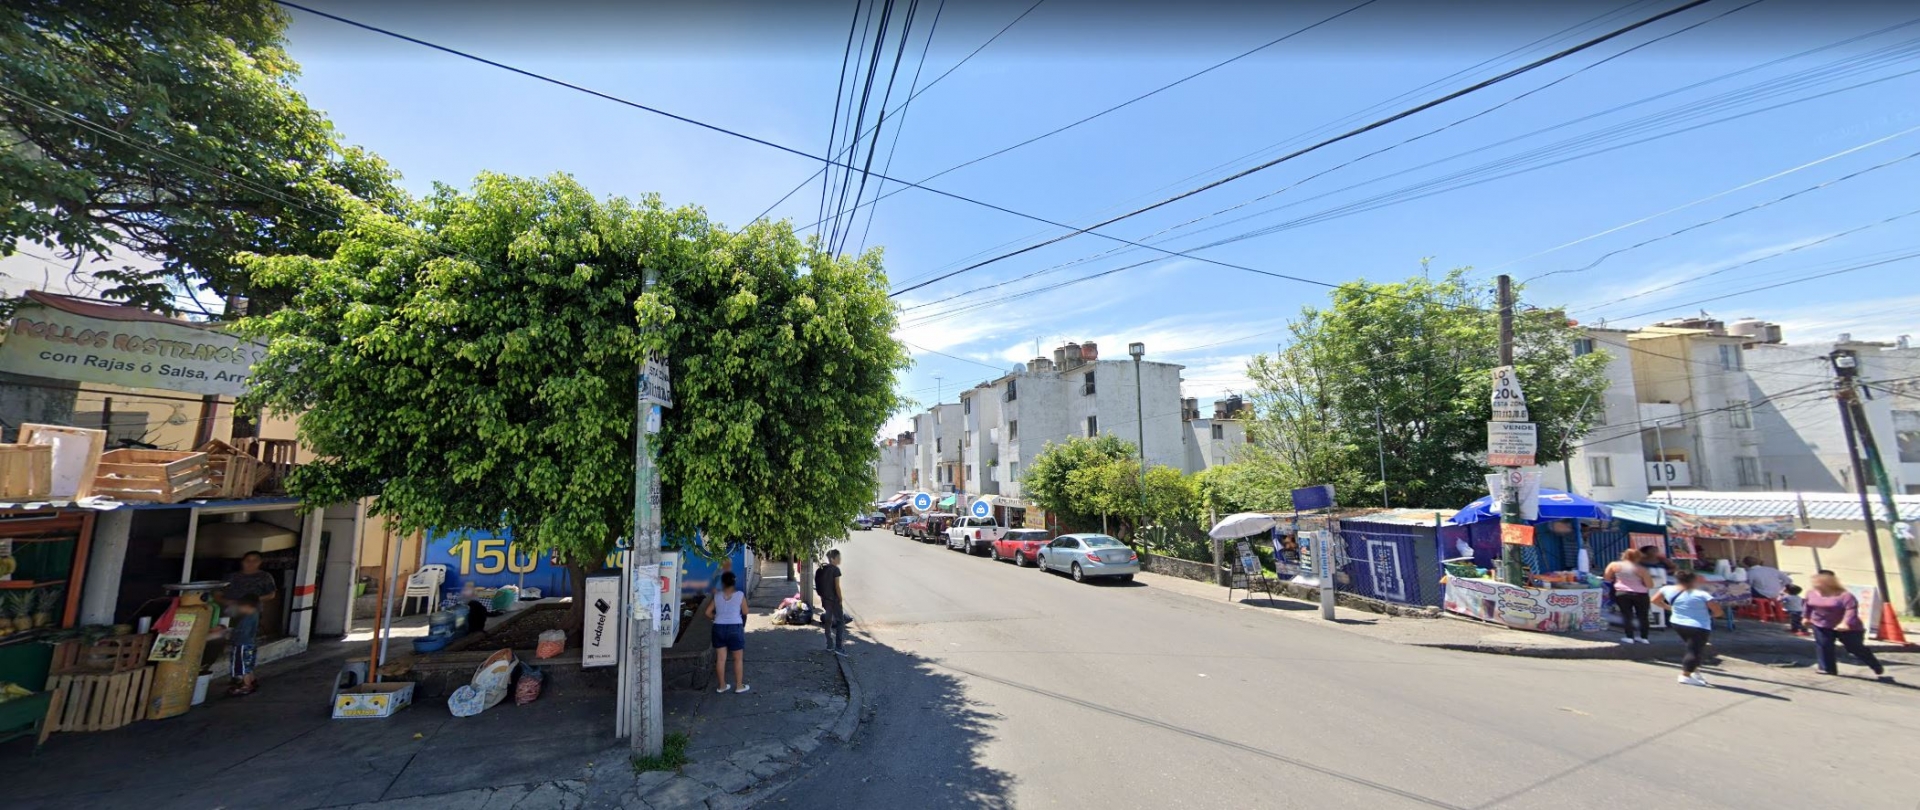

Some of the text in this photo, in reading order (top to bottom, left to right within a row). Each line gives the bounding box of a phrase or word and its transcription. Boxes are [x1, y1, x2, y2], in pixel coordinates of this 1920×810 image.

[14, 317, 108, 349] POLLOS
[113, 333, 247, 365] ROSTIZADOS
[40, 351, 250, 385] con Rajas ó Salsa, Arr
[1653, 463, 1676, 482] 19
[449, 538, 539, 575] 150
[592, 613, 607, 648] Ladatel
